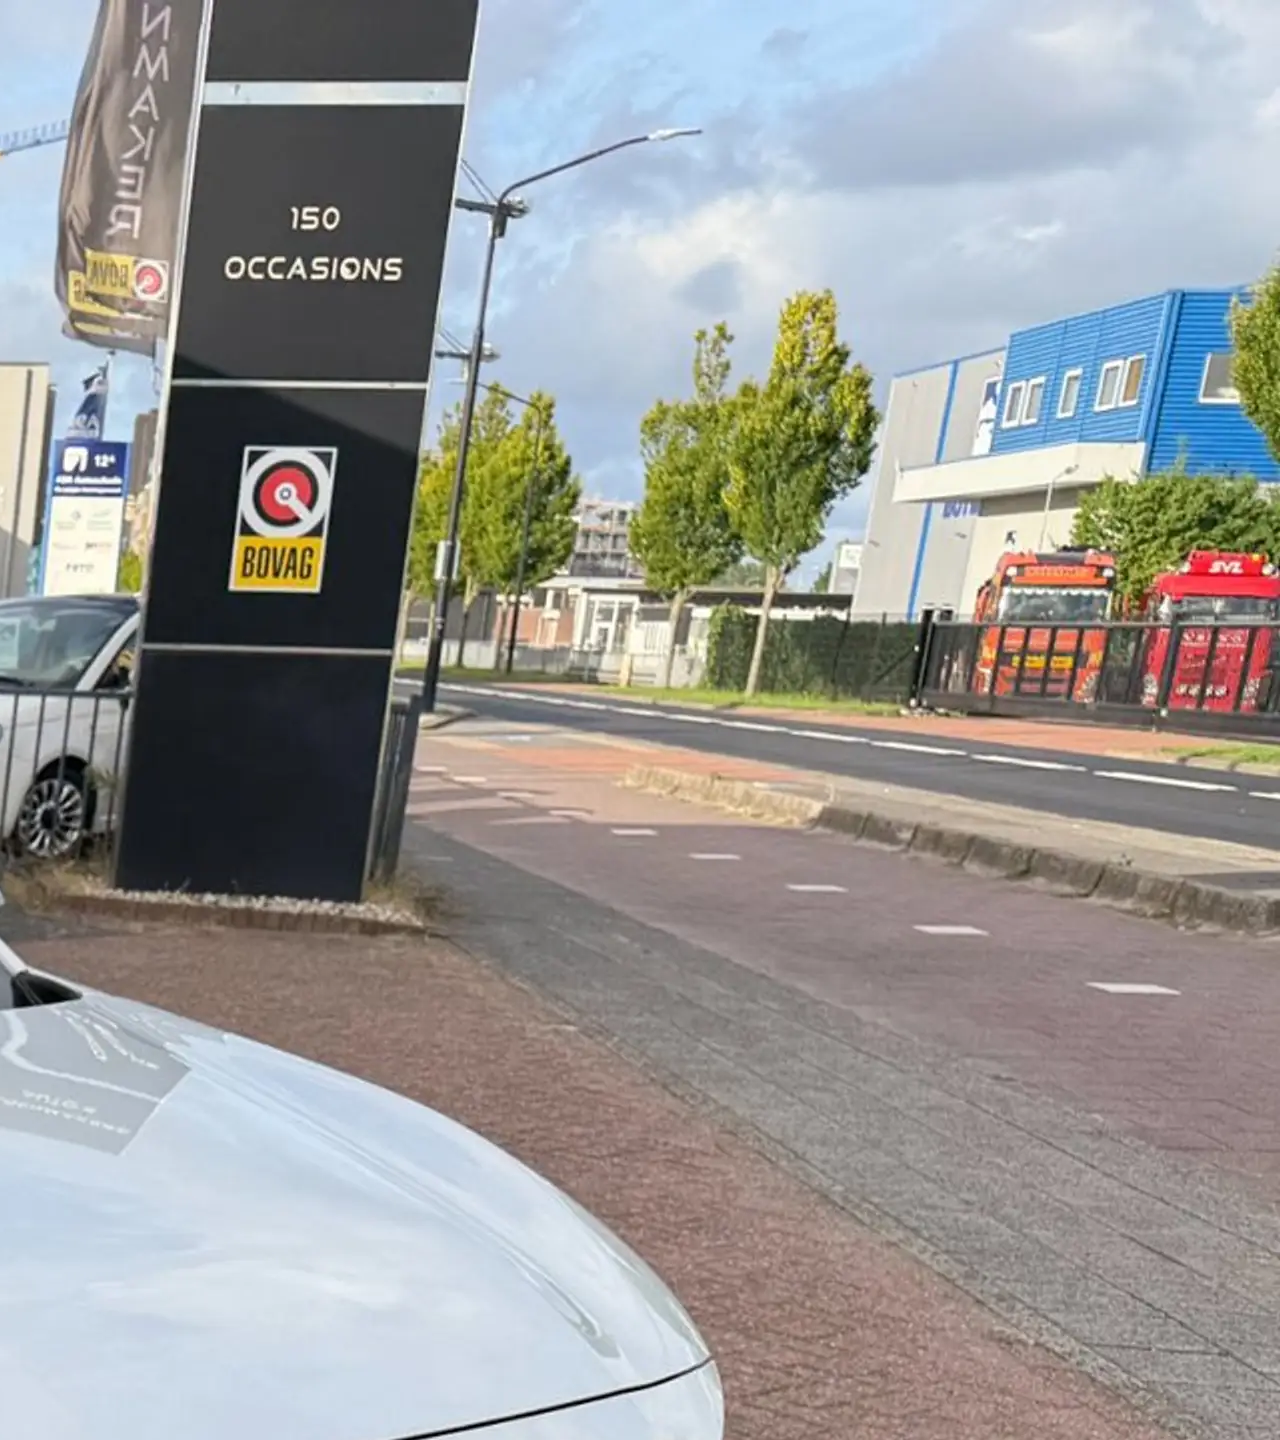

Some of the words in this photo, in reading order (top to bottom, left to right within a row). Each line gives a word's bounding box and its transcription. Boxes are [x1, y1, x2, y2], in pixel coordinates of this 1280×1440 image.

[290, 206, 340, 231] 150
[224, 256, 404, 282] OCCASIONS
[242, 546, 314, 580] BOVAG
